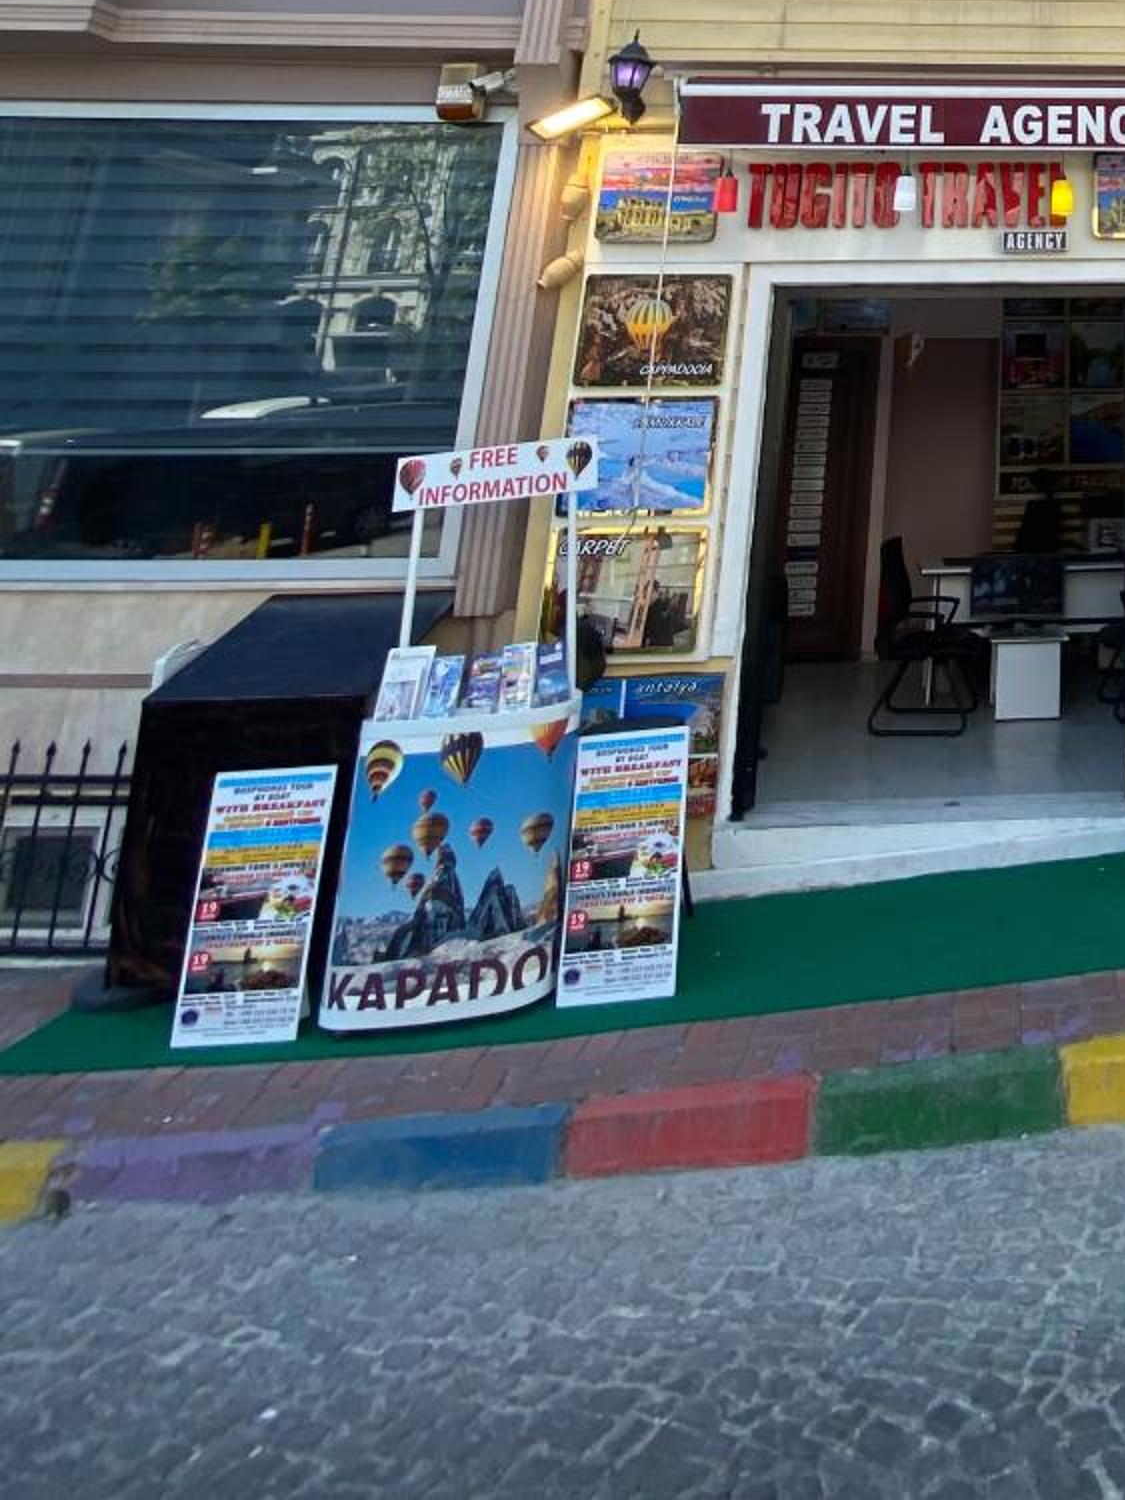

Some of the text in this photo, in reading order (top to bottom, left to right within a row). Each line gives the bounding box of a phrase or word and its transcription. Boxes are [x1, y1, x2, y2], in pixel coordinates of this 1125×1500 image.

[761, 104, 945, 144] TRAVEL
[918, 162, 1067, 228] TRAVEL
[1007, 232, 1063, 249] AGENCY
[469, 447, 519, 470] FREE
[419, 472, 567, 505] INFORMATION
[575, 861, 590, 873] 19
[202, 901, 217, 913] 19
[571, 913, 585, 925] 19
[193, 953, 209, 964] 19
[326, 942, 549, 1011] KAPADO
